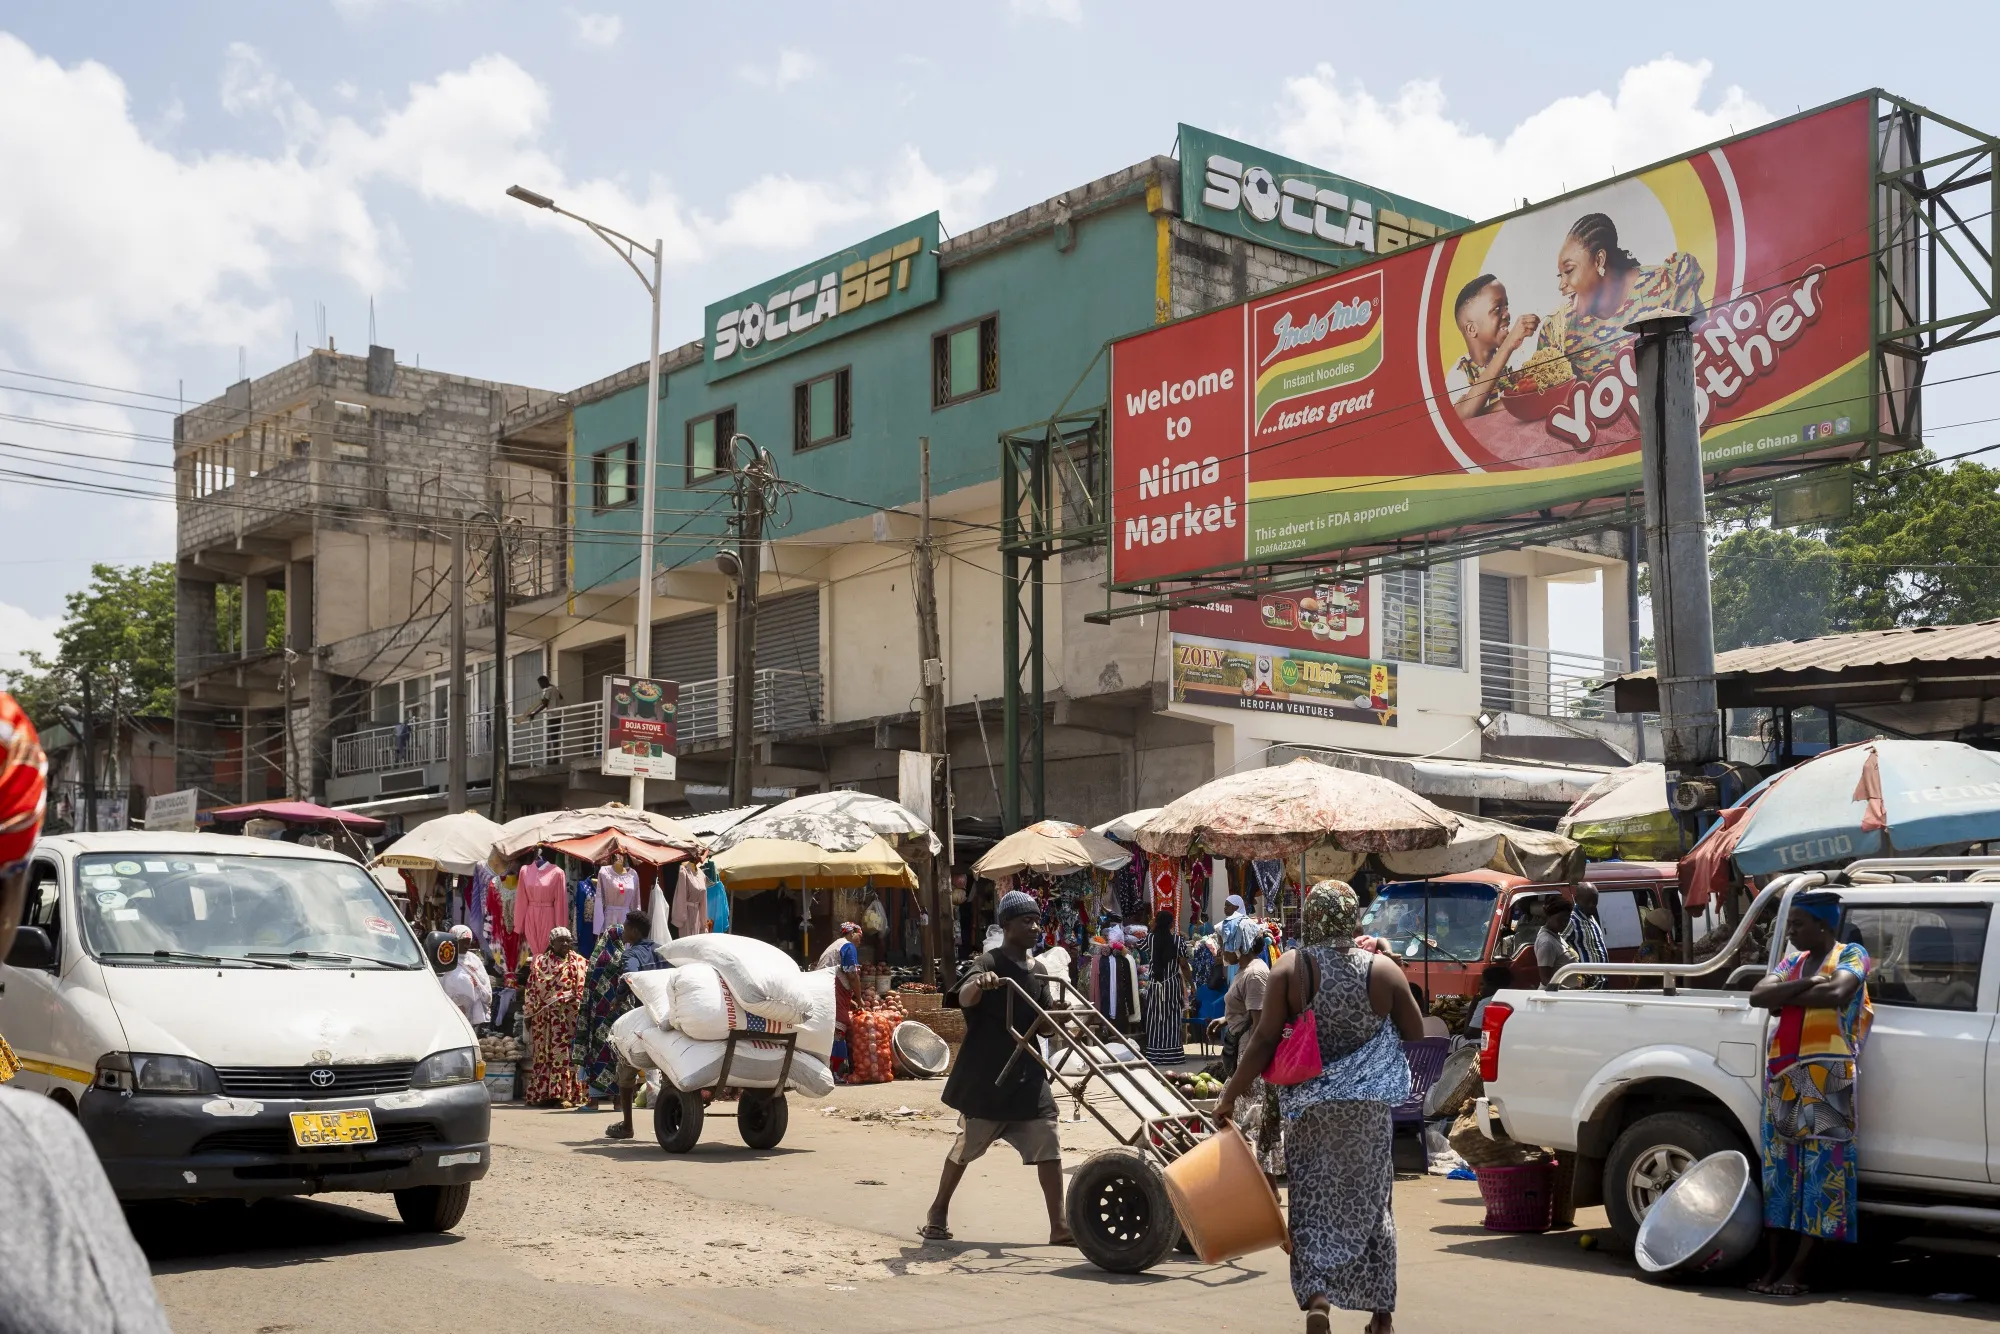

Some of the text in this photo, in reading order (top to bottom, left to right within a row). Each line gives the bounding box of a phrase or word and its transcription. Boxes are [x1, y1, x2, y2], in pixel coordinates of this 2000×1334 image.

[714, 237, 923, 360] SOCCABET
[1284, 362, 1355, 389] Instant Noodles
[1126, 368, 1234, 416] Welcome
[1327, 389, 1375, 423] great
[1166, 416, 1191, 441] to
[1703, 434, 1798, 461] Indomie Ghana
[1139, 456, 1220, 500] Nima
[1125, 496, 1237, 550] Market
[1255, 498, 1410, 541] This advert is FDA approved
[1215, 603, 1233, 613] 9481
[1181, 645, 1225, 669] ZOEY
[1303, 661, 1341, 688] Maple
[1240, 698, 1334, 717] HEROFAM VENTURES
[625, 721, 662, 732] BOJA STOVE
[386, 857, 400, 865] MTN
[1773, 835, 1853, 865] TECNO
[320, 1115, 342, 1127] GR
